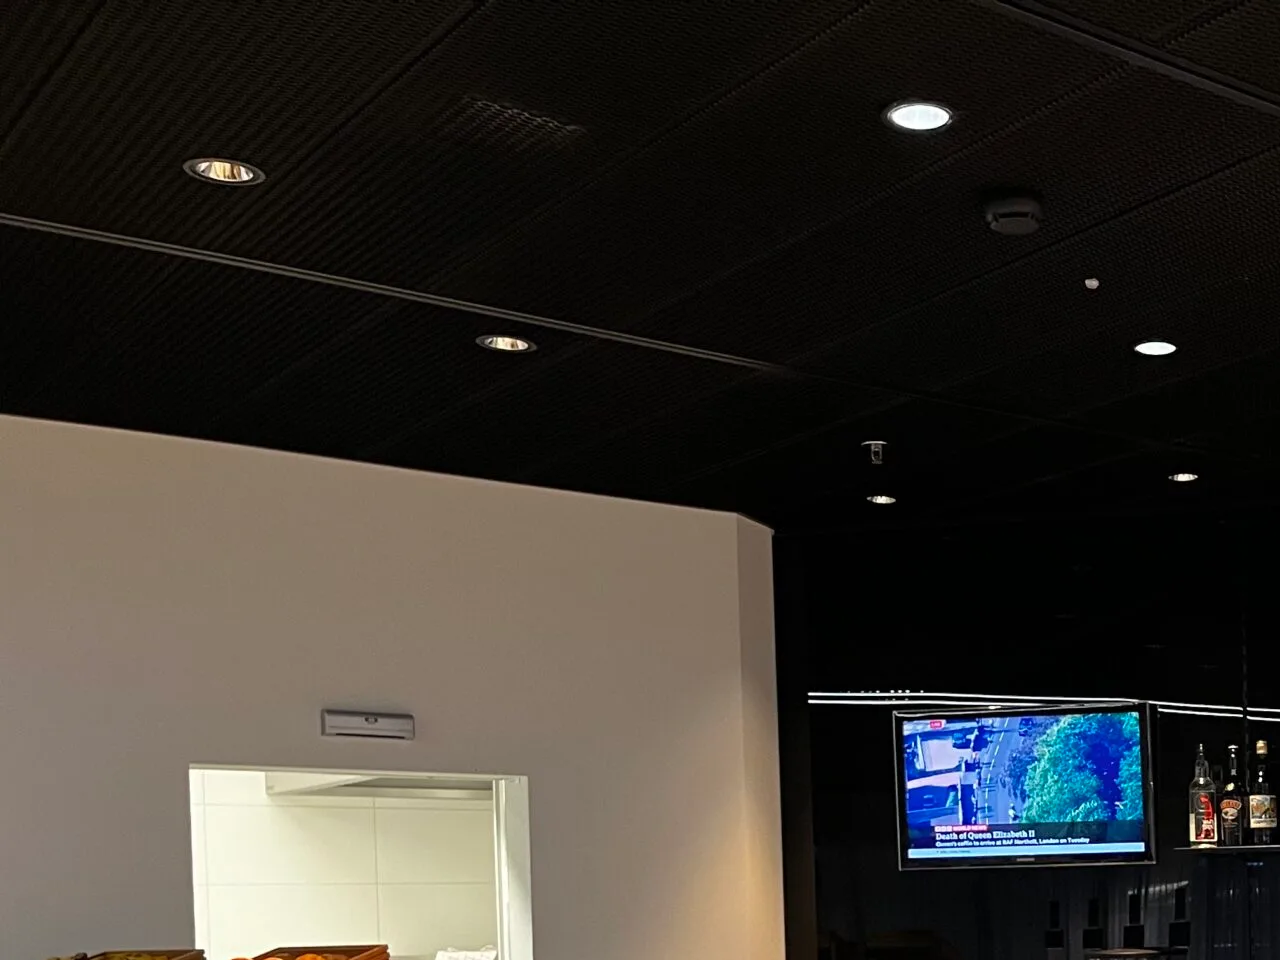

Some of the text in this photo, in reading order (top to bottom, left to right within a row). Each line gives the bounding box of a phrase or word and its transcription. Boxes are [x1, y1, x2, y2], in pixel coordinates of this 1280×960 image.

[936, 832, 958, 840] Death
[959, 831, 967, 839] of
[968, 831, 992, 840] Queen
